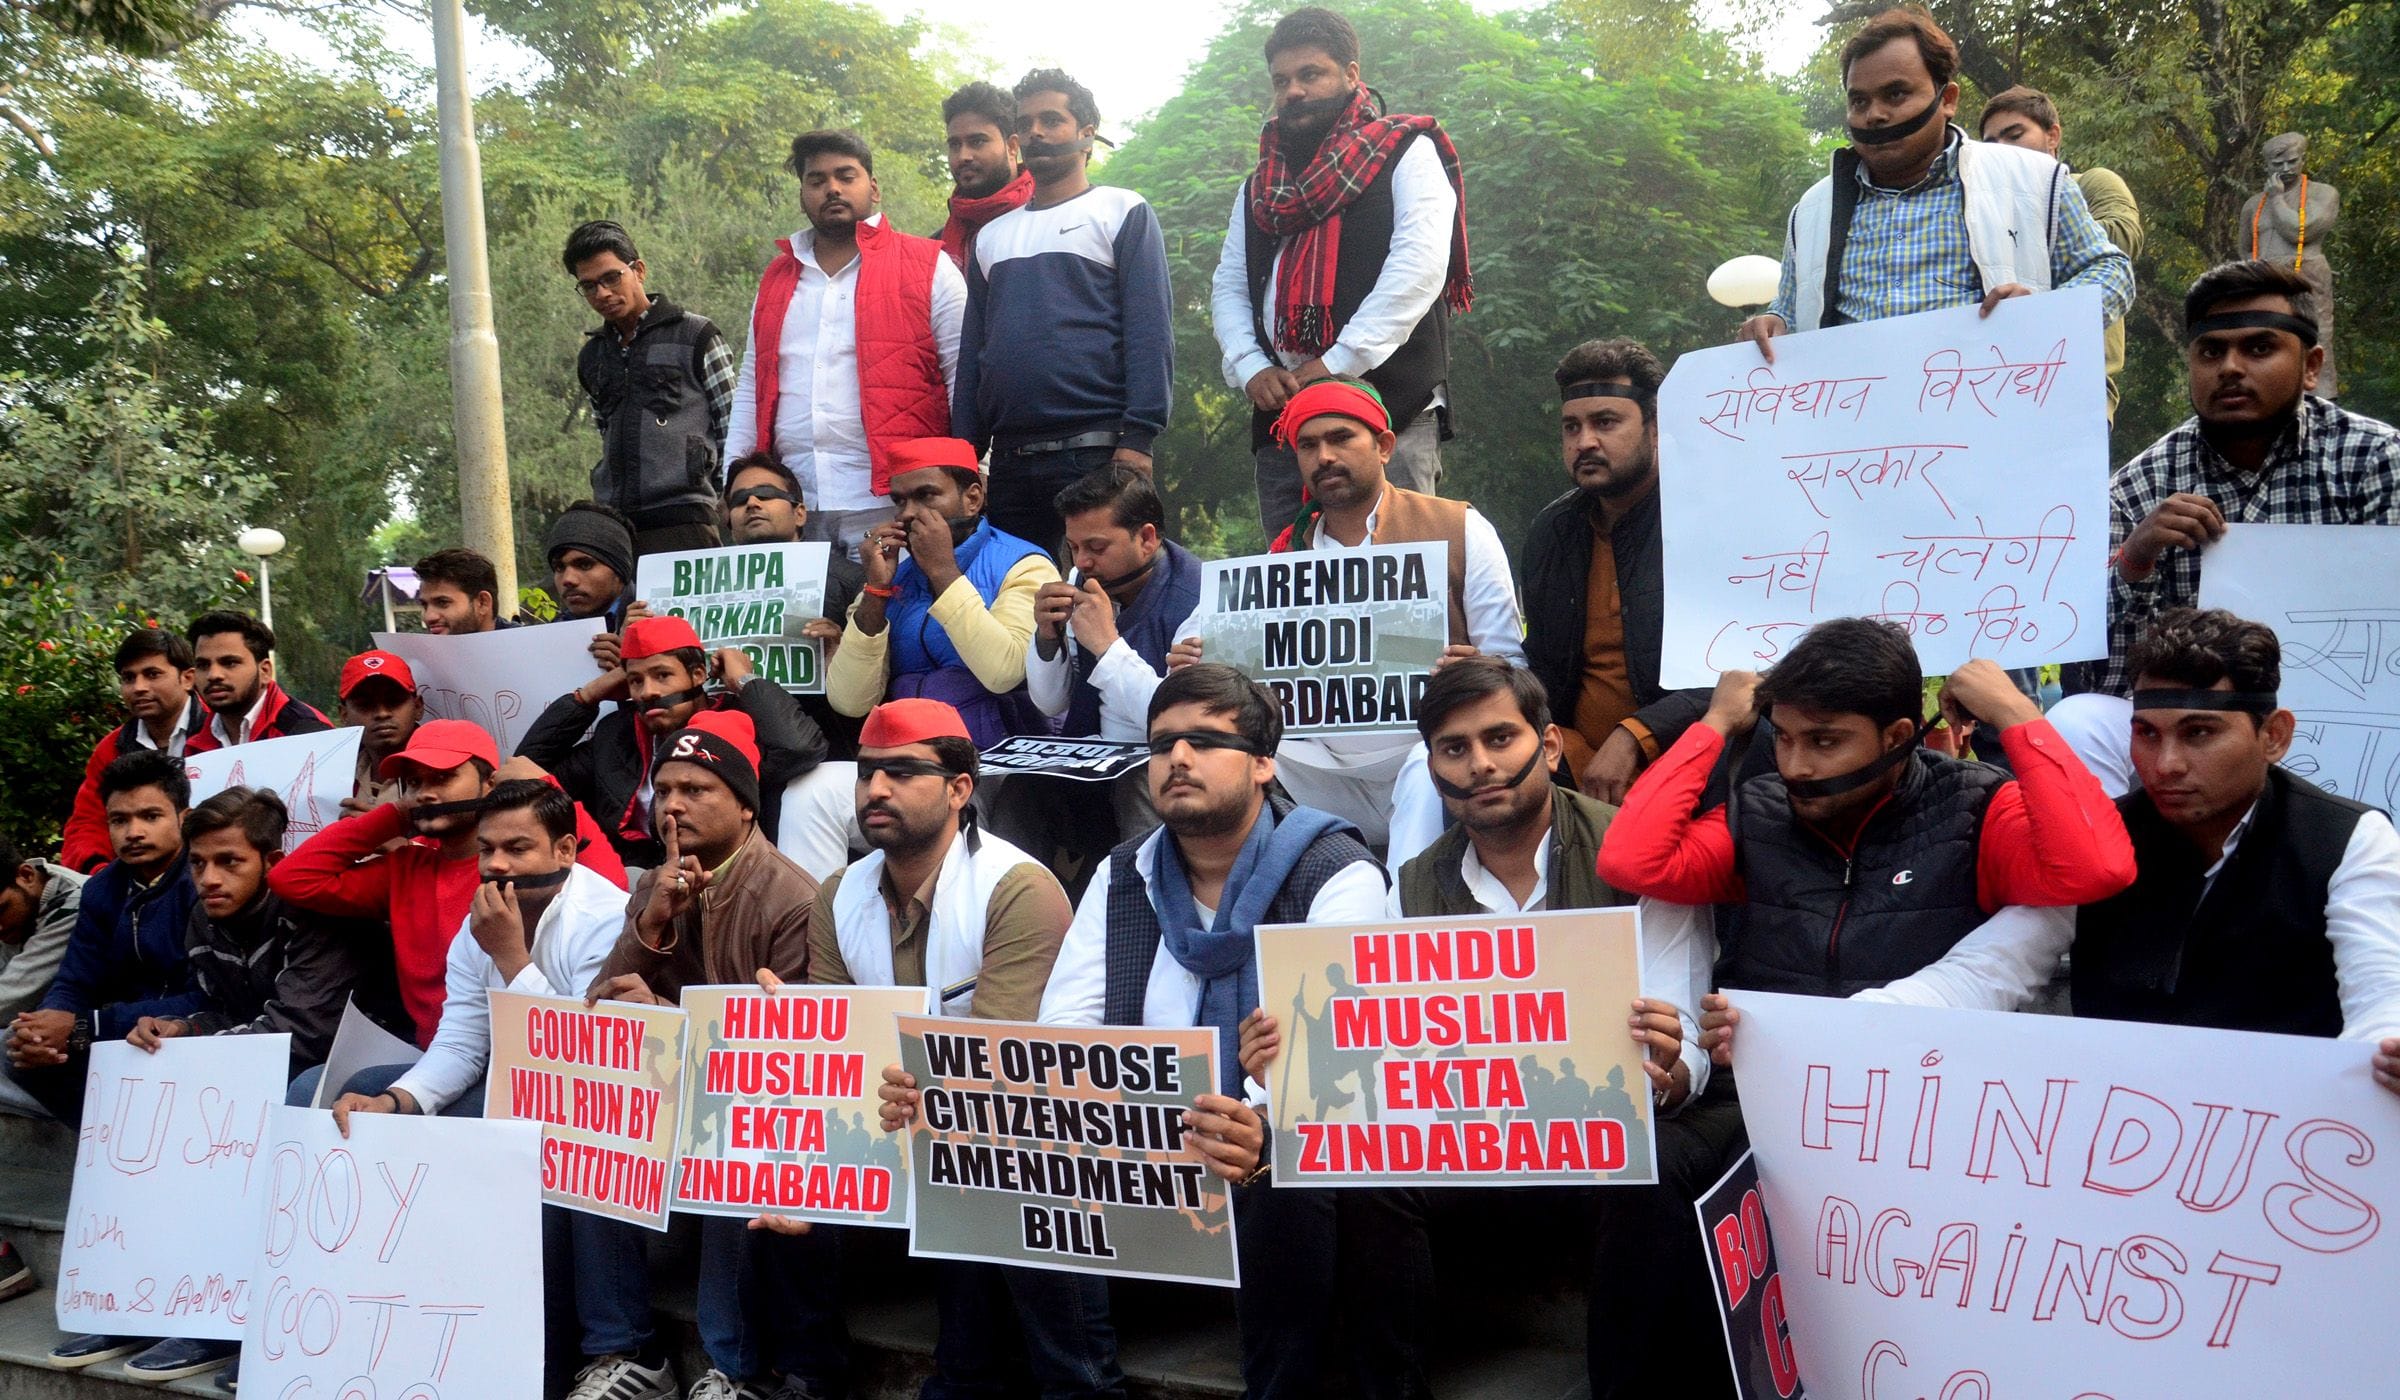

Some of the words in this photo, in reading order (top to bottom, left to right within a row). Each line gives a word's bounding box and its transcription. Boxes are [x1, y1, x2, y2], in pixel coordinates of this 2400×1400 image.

[1699, 368, 1887, 441] संविधान
[1919, 338, 2066, 417] विरोधी
[1781, 445, 1968, 519] सरकार
[672, 551, 784, 597] BHAJPA
[1217, 553, 1429, 613] NARENDRA
[1264, 616, 1372, 668] MODI
[1255, 674, 1432, 728] RDABAD
[1353, 928, 1536, 984] HINDU
[527, 1006, 645, 1071] COUNTRY
[723, 997, 849, 1042] HINDU
[1333, 991, 1568, 1048] MUSLIM
[706, 1051, 865, 1098] MUSLIM
[924, 1033, 993, 1080] WE
[999, 1038, 1180, 1094] OPPOSE
[1384, 1058, 1525, 1109] EKTA
[511, 1069, 566, 1125] WILL
[573, 1078, 627, 1133] RUN
[629, 1090, 661, 1142] BY
[731, 1107, 826, 1153] EKTA
[923, 1088, 1188, 1151] CITIZENSHIP
[1298, 1120, 1625, 1172] ZINDABAAD
[266, 1141, 429, 1268] BOY
[542, 1138, 666, 1215] STITUTION
[677, 1158, 892, 1213] ZINDABAAD
[930, 1143, 1205, 1209] AMENDMENT
[1022, 1204, 1116, 1257] BILL
[1713, 1180, 1768, 1312] BO
